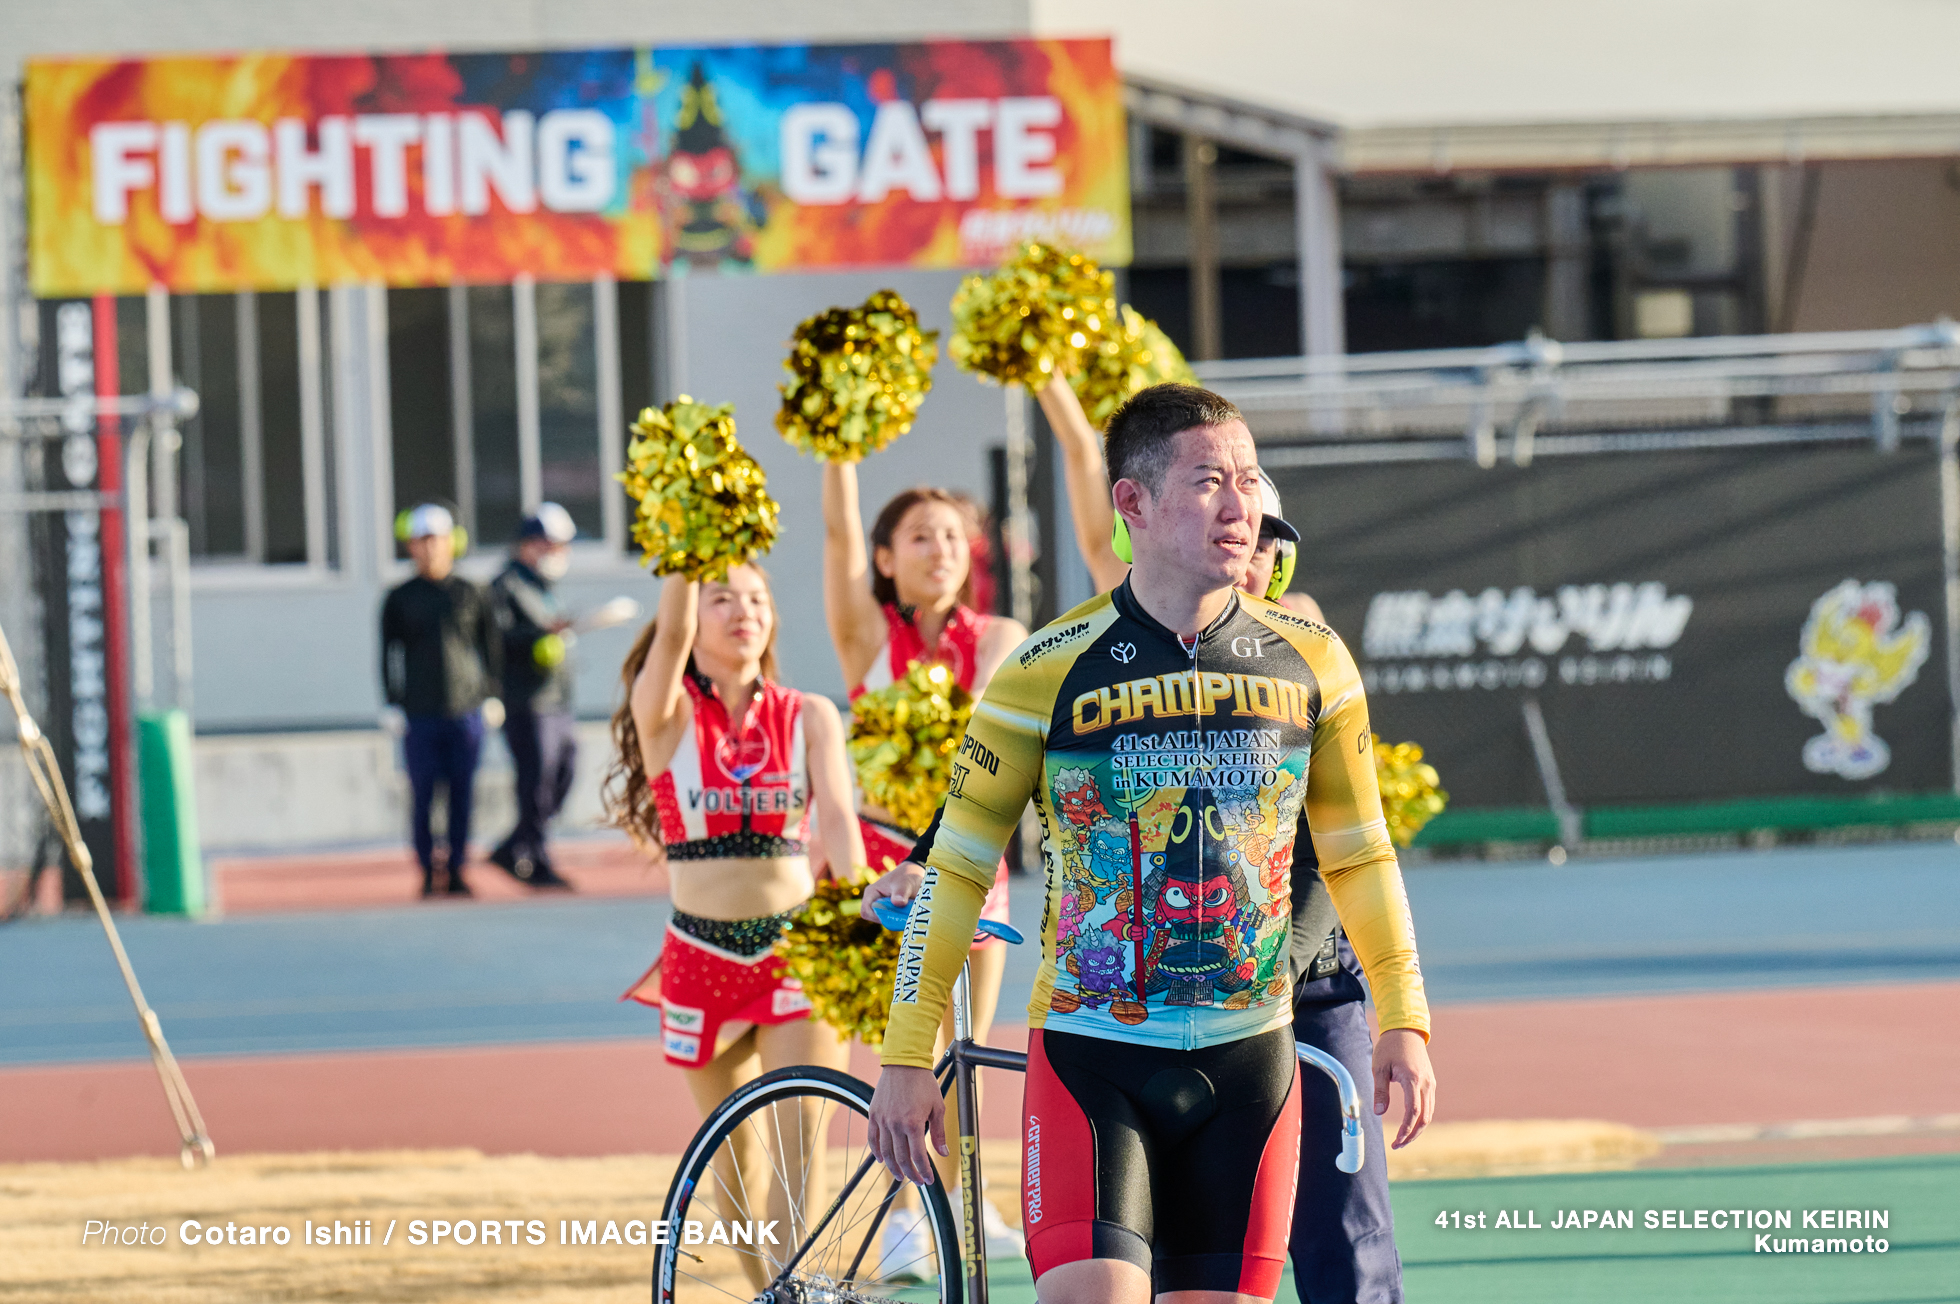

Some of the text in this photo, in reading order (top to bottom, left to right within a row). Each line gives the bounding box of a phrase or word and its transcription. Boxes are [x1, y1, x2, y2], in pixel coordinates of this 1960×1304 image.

[91, 97, 1067, 223] FIGHTING GATE
[1265, 615, 1305, 630] KUMAMOTO
[1020, 622, 1090, 667] 熊本けいりん
[1023, 630, 1090, 670] KUMAMOTO KEIRIN
[1072, 669, 1309, 736] CHAMPION
[1113, 731, 1279, 752] 41st ALL JAPAN
[1113, 752, 1279, 769] SELECTION KEIRIN
[1115, 769, 1278, 789] in KUMAMOTO
[688, 786, 805, 816] VOLTERS
[1032, 787, 1051, 842] CLUB
[921, 866, 938, 901] 41st
[911, 904, 931, 941] ALL
[902, 944, 925, 1004] JAPAN
[960, 1135, 982, 1278] Panasonic
